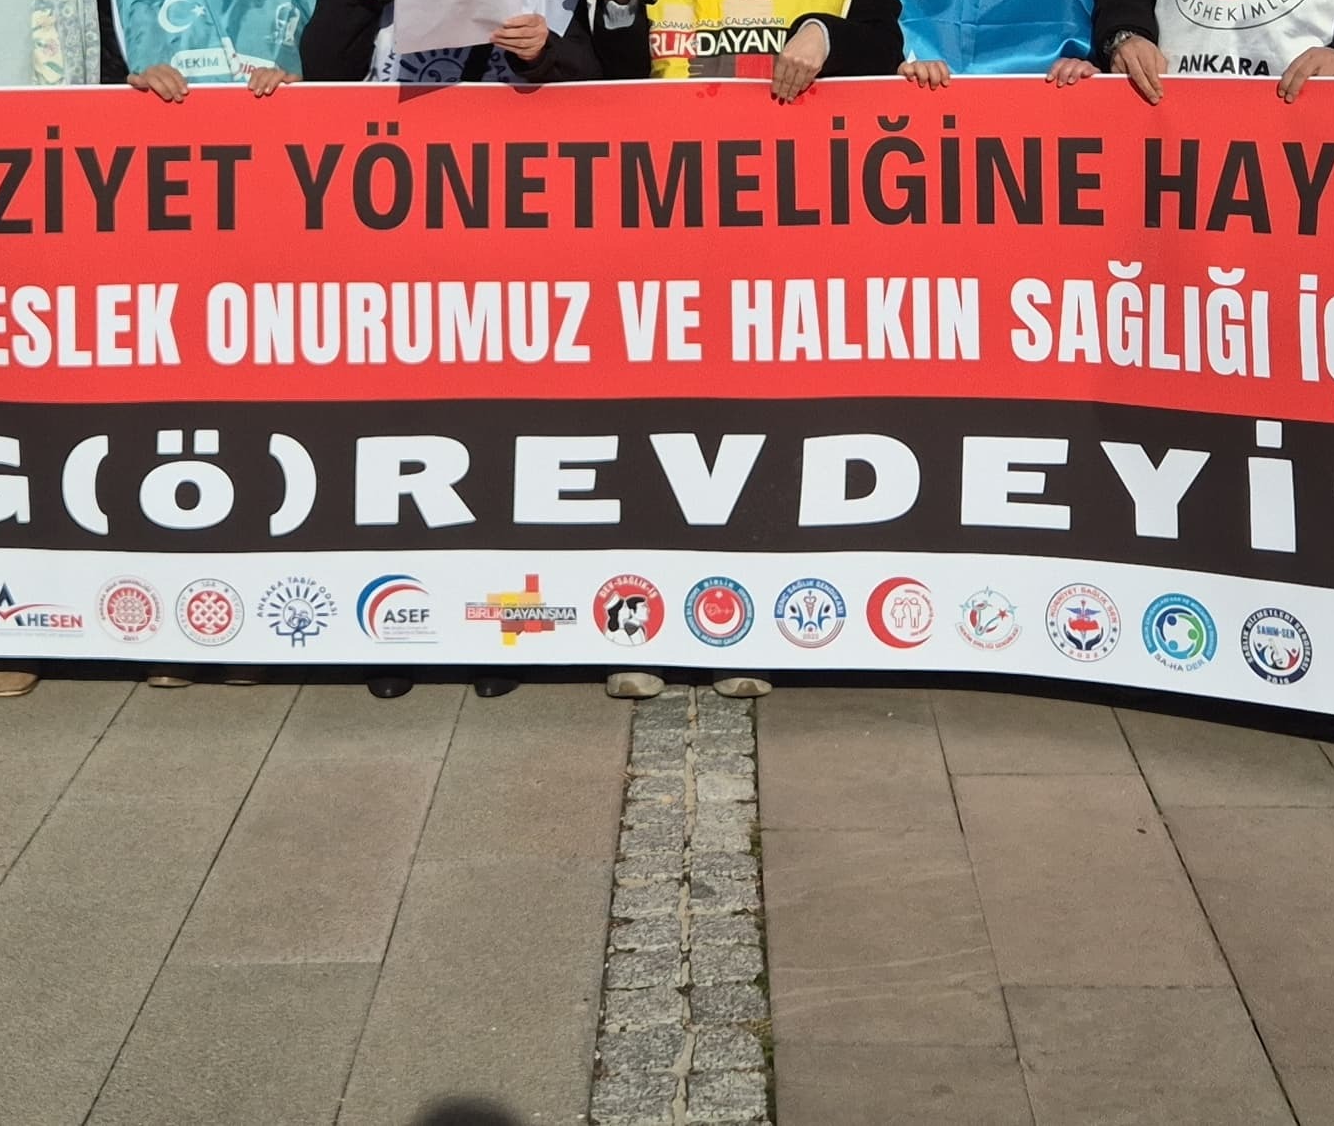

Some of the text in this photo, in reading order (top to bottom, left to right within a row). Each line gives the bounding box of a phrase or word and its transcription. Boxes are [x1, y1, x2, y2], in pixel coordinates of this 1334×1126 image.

[1178, 54, 1271, 76] ANKARA
[286, 115, 1106, 231] YÖNETMELİĞİNE
[206, 280, 591, 366] ONURUMUZ
[619, 279, 703, 363] VE
[731, 277, 980, 363] HALKIN
[1010, 260, 1271, 380] SAĞLIĞI
[383, 608, 430, 624] ASEF
